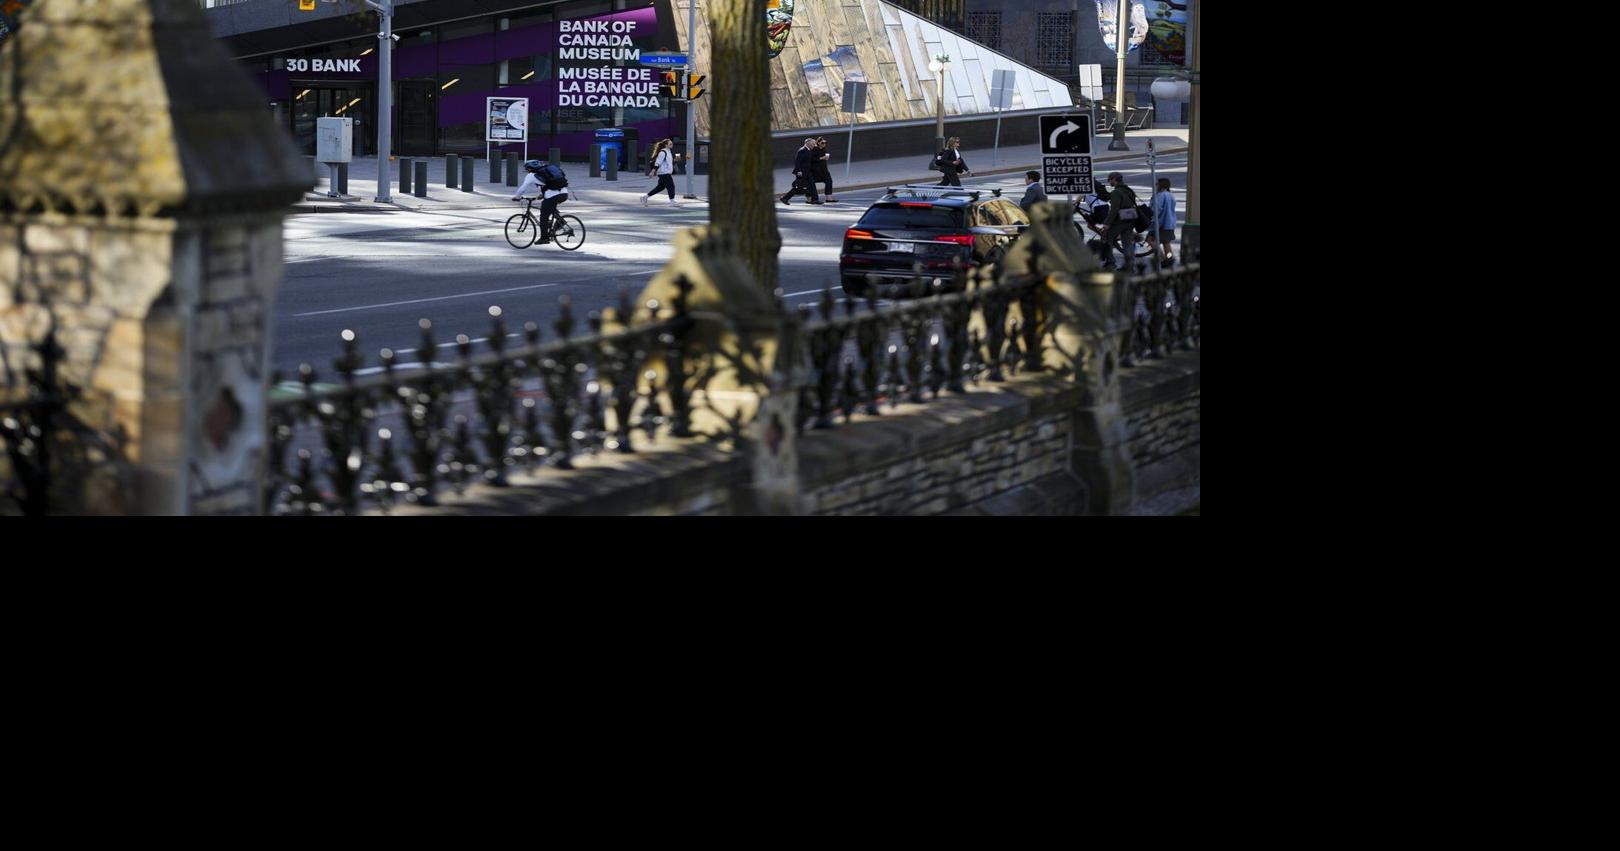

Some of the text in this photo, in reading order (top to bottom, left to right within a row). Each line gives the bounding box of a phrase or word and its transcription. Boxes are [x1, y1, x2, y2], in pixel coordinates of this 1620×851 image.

[560, 20, 636, 33] BANK OF
[559, 34, 633, 46] CANADA
[559, 48, 640, 60] MUSEUM
[286, 58, 361, 72] 30 BANK
[559, 65, 650, 80] MUSÉE DE
[559, 81, 660, 94] LA BANQUE
[559, 95, 660, 108] DU CANADA
